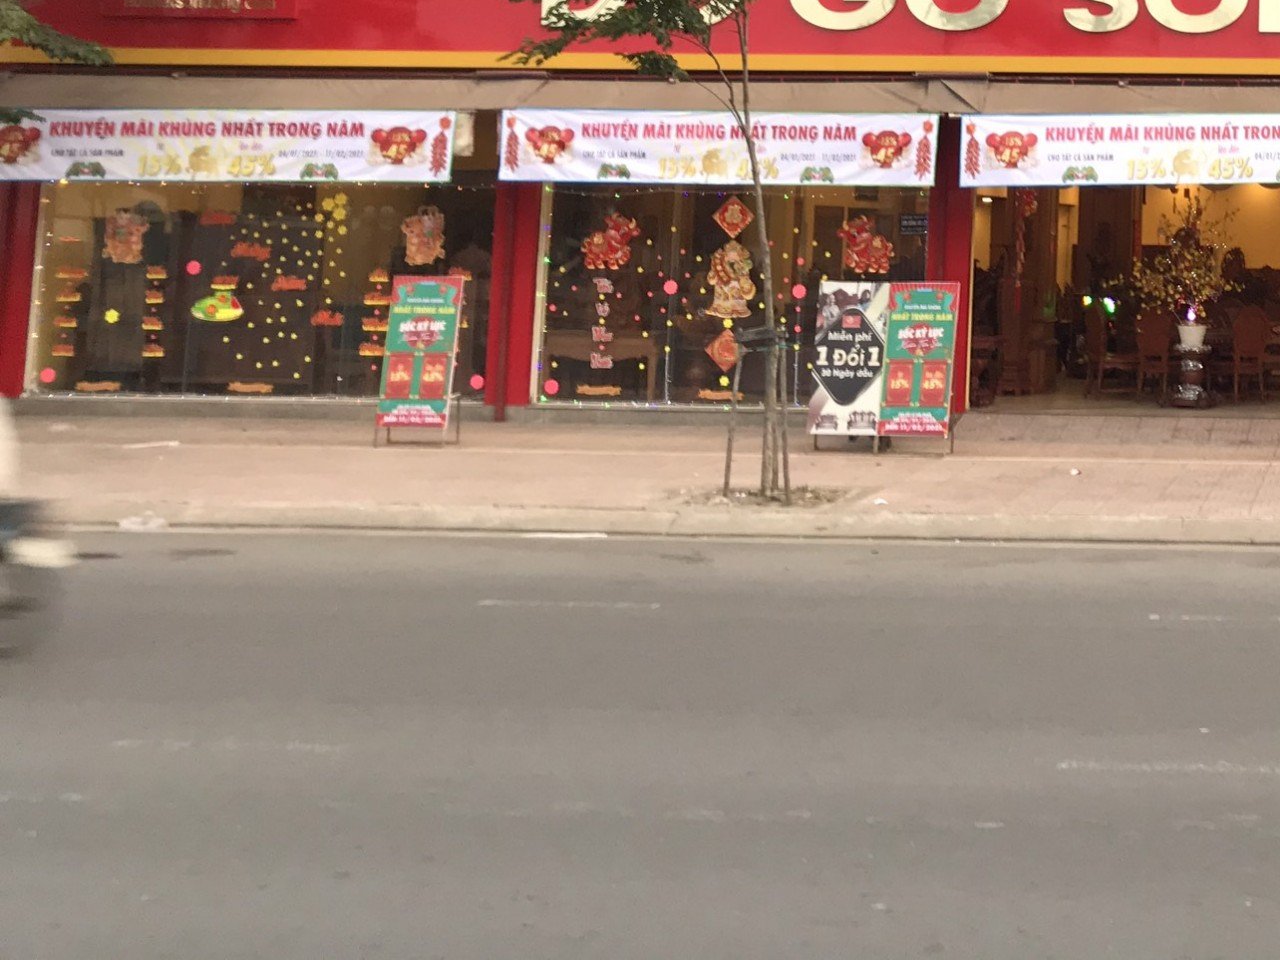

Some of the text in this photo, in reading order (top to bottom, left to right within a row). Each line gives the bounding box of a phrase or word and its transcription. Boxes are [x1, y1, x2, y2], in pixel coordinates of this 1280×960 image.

[1127, 157, 1166, 180] 15%
[1208, 155, 1254, 180] 45%
[816, 345, 829, 366] 1
[832, 343, 866, 366] Đổi
[867, 345, 880, 367] 1
